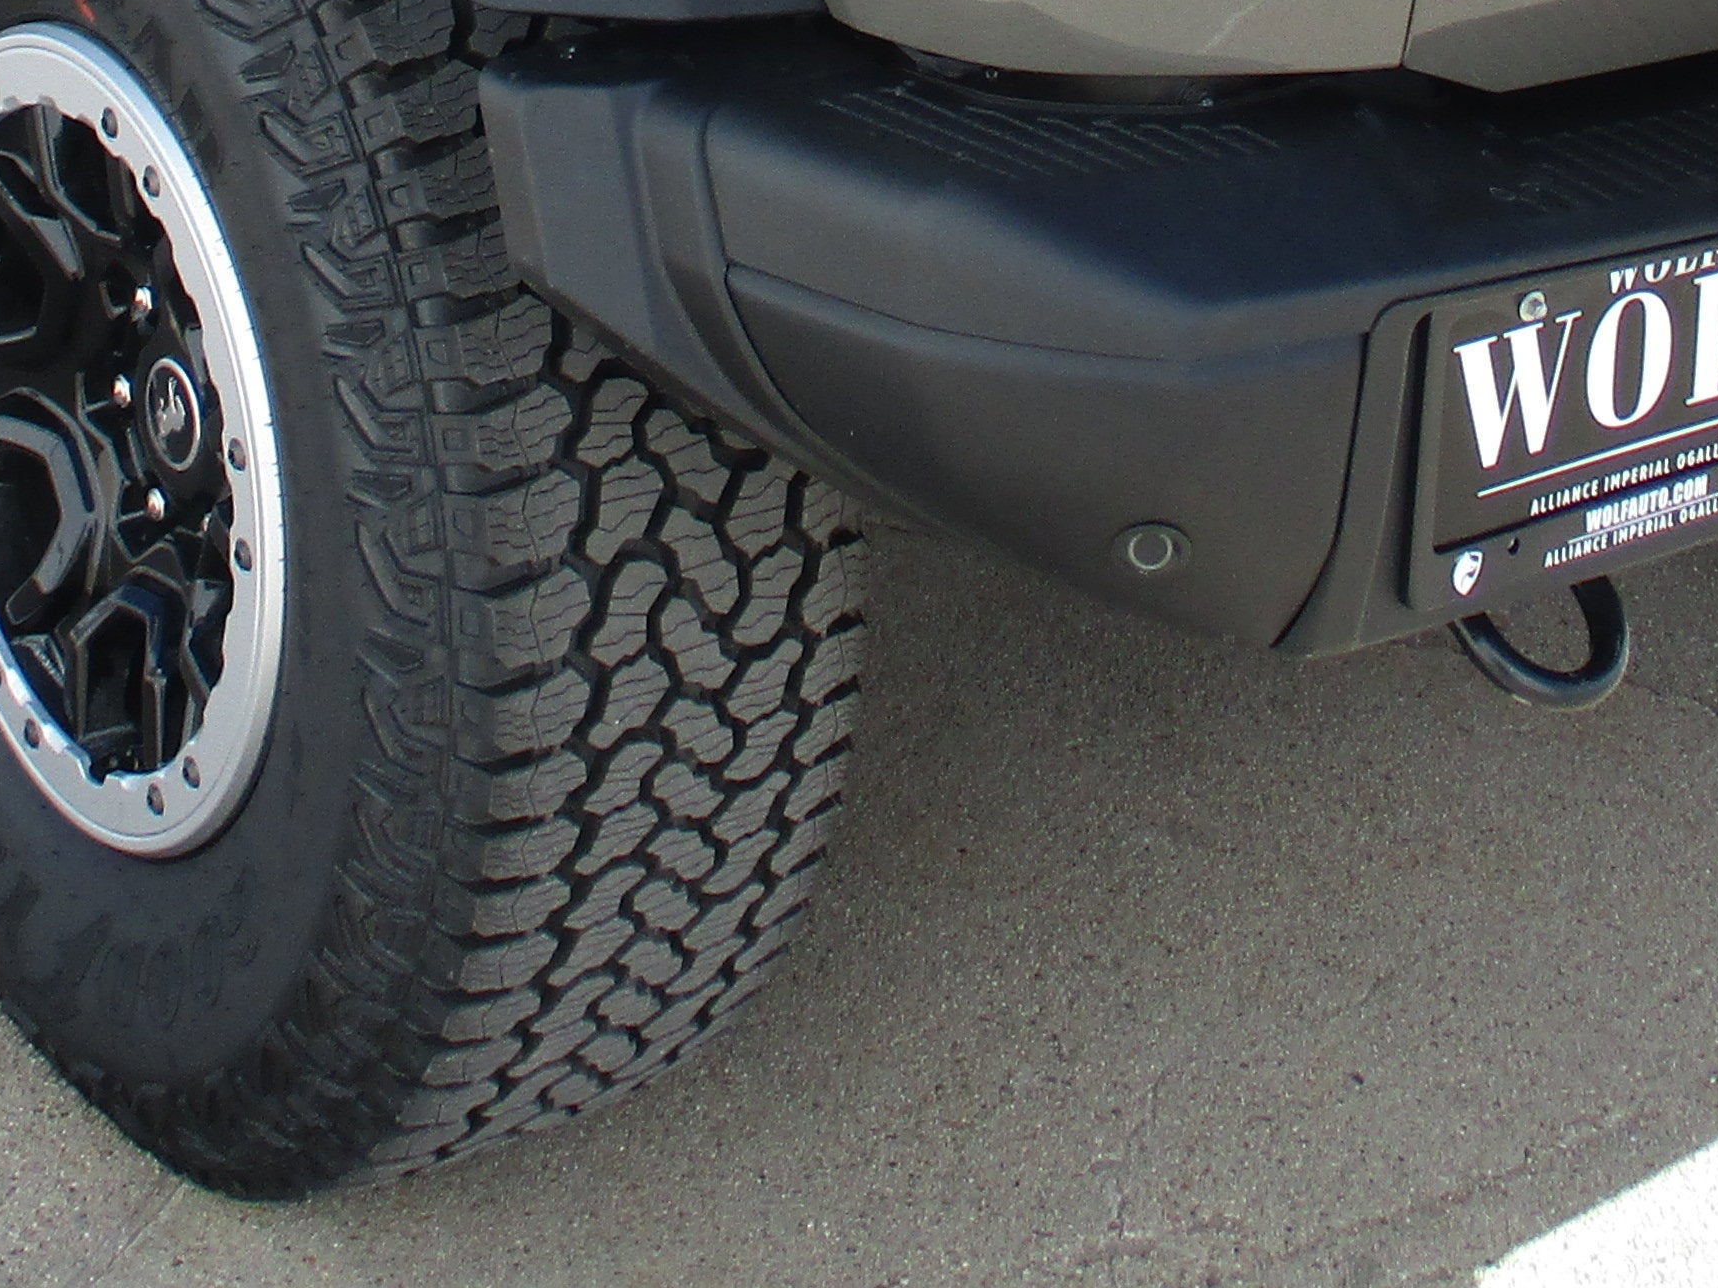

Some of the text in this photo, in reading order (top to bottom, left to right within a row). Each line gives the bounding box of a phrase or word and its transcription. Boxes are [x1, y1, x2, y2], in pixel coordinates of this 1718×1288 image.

[1530, 478, 1599, 517] ALLIANCE
[1603, 457, 1671, 492] IMPERIAL
[1585, 474, 1709, 534] WOLFAUTO.COM
[1544, 532, 1609, 568] ALLIANCE
[1612, 511, 1674, 546] IMPERIAL
